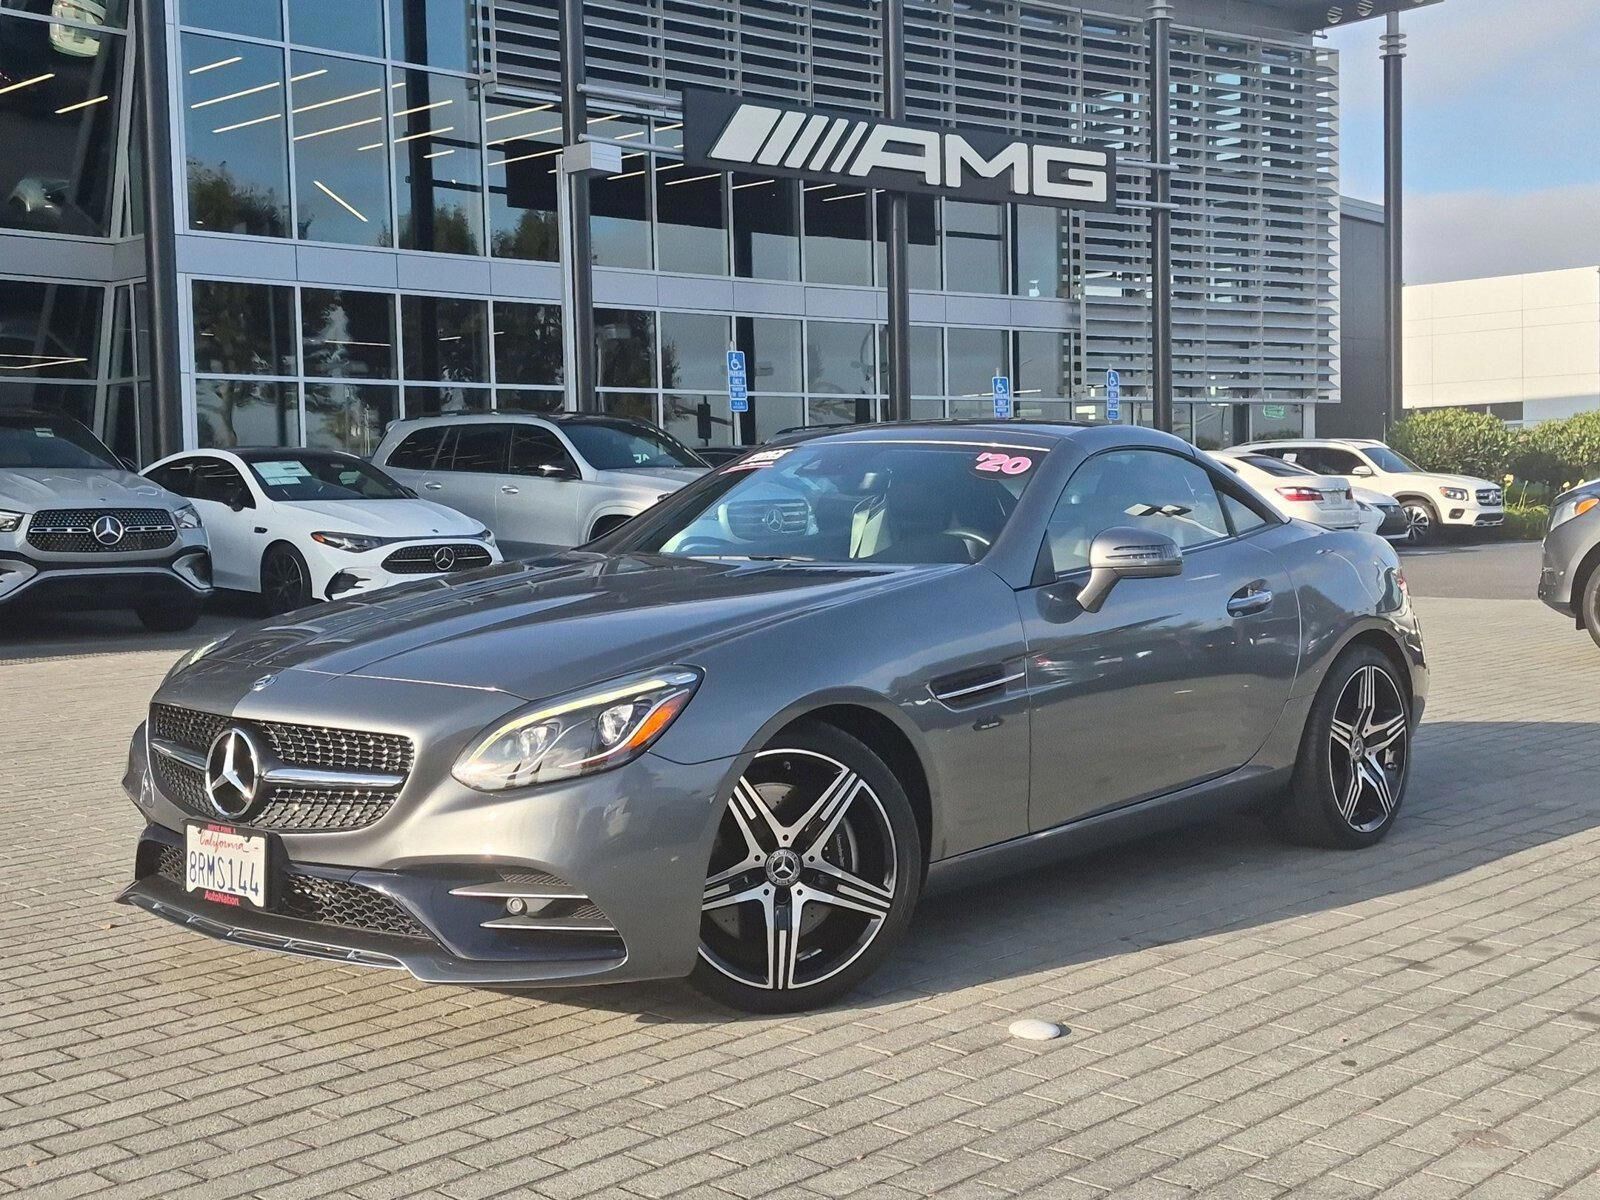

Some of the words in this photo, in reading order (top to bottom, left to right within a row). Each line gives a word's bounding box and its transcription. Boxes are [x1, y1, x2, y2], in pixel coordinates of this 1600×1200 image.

[848, 123, 1108, 203] AMG
[200, 829, 250, 853] California
[189, 850, 259, 896] 8RMS144
[204, 889, 241, 906] AutoNation
